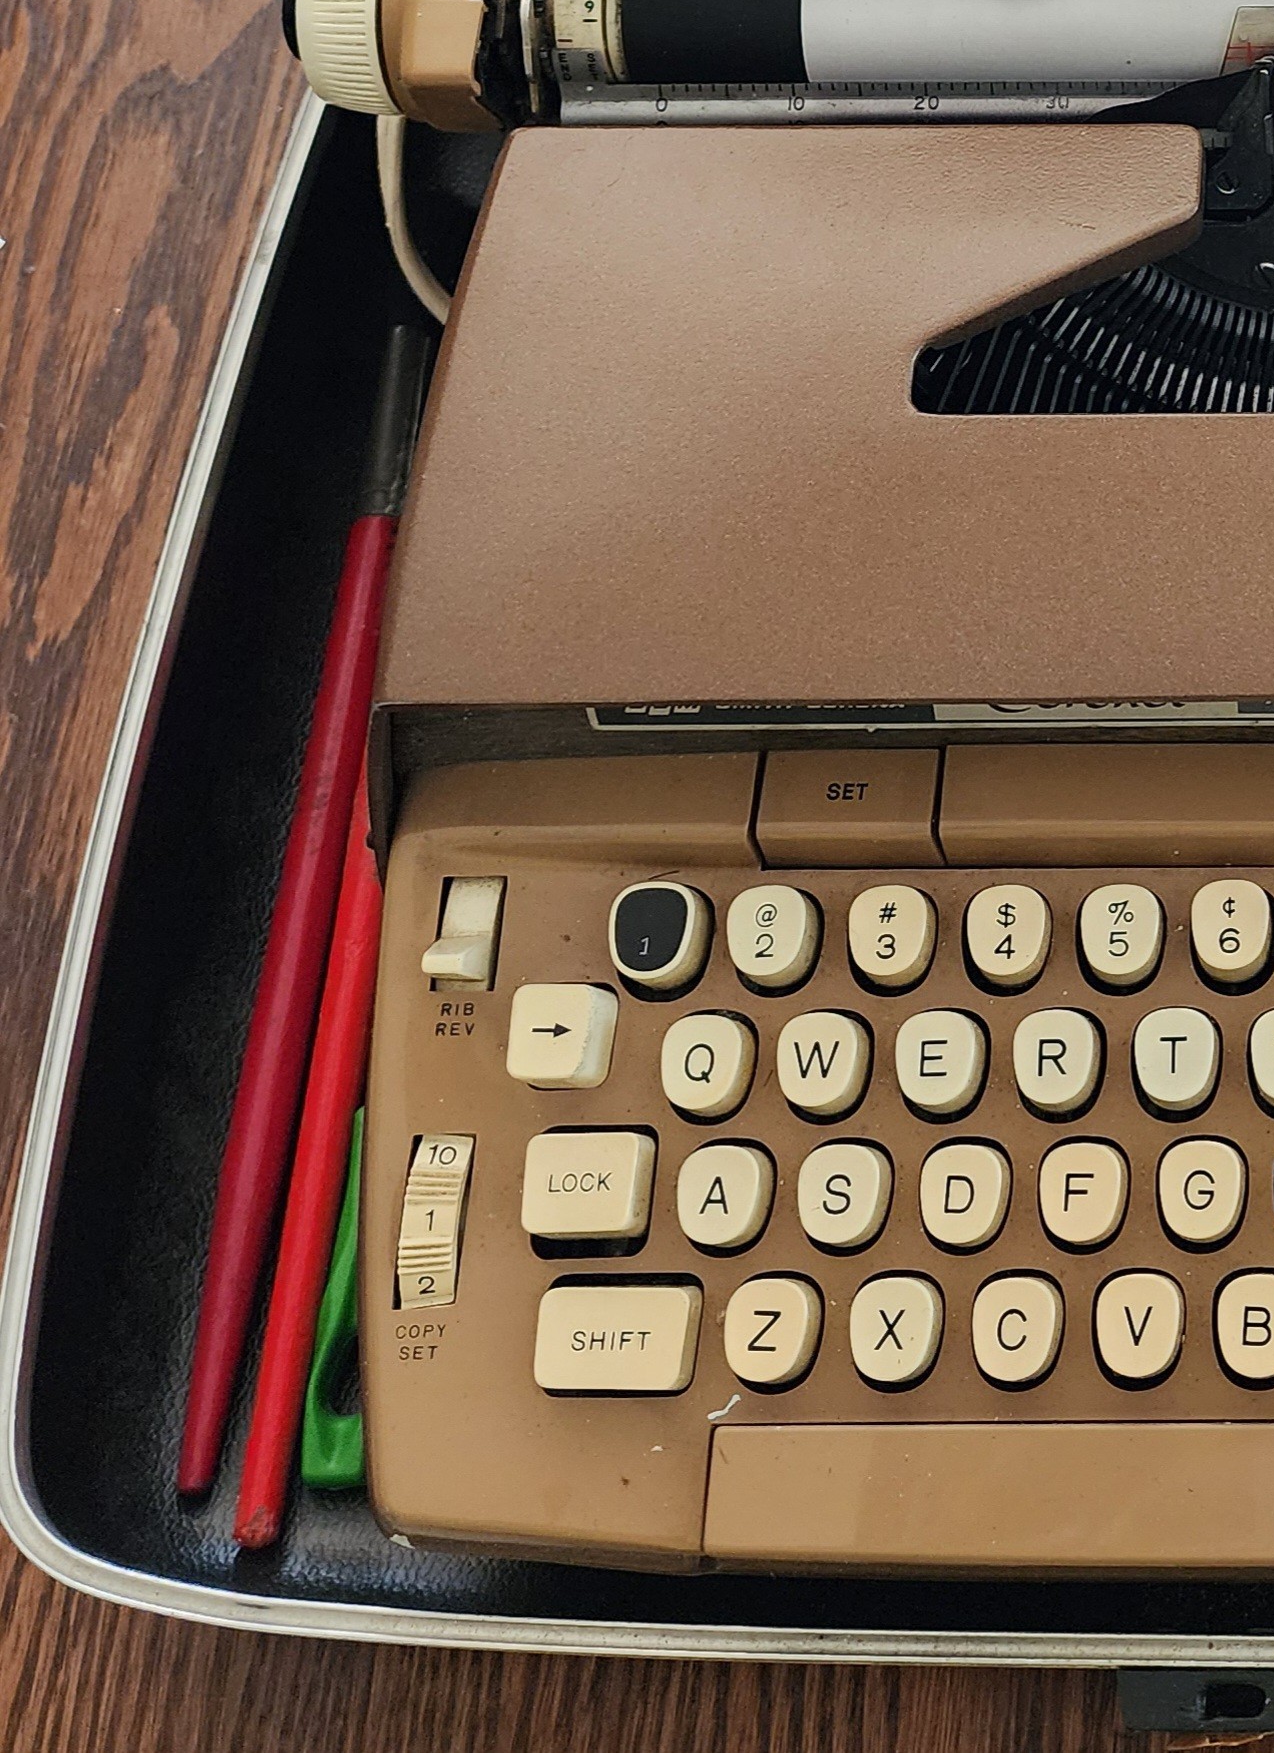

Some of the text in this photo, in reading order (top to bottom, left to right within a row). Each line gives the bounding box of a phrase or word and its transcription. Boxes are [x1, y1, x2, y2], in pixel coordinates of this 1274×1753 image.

[914, 95, 940, 111] 20
[826, 783, 868, 800] SET
[755, 934, 773, 958] 2
[876, 934, 895, 959] 3
[994, 934, 1015, 959] 4
[1109, 932, 1129, 956] 5
[1219, 928, 1240, 953] 6
[441, 1003, 474, 1016] RIB
[435, 1023, 474, 1036] REV
[685, 1044, 714, 1083] Q
[794, 1041, 839, 1078] W
[920, 1040, 947, 1077] E
[1038, 1039, 1066, 1076] R
[1160, 1036, 1187, 1073] T
[429, 1144, 456, 1165] 10
[549, 1173, 611, 1192] LOCK
[700, 1177, 728, 1214] A
[823, 1174, 851, 1214] S
[944, 1176, 974, 1213] D
[1064, 1173, 1094, 1211] F
[1184, 1170, 1215, 1210] G
[396, 1325, 446, 1339] COPY
[572, 1331, 651, 1351] SHIFT
[748, 1311, 781, 1351] Z
[875, 1310, 905, 1350] X
[997, 1309, 1027, 1351] C
[1125, 1306, 1153, 1346] V
[1242, 1306, 1271, 1346] B
[399, 1346, 438, 1360] SET
